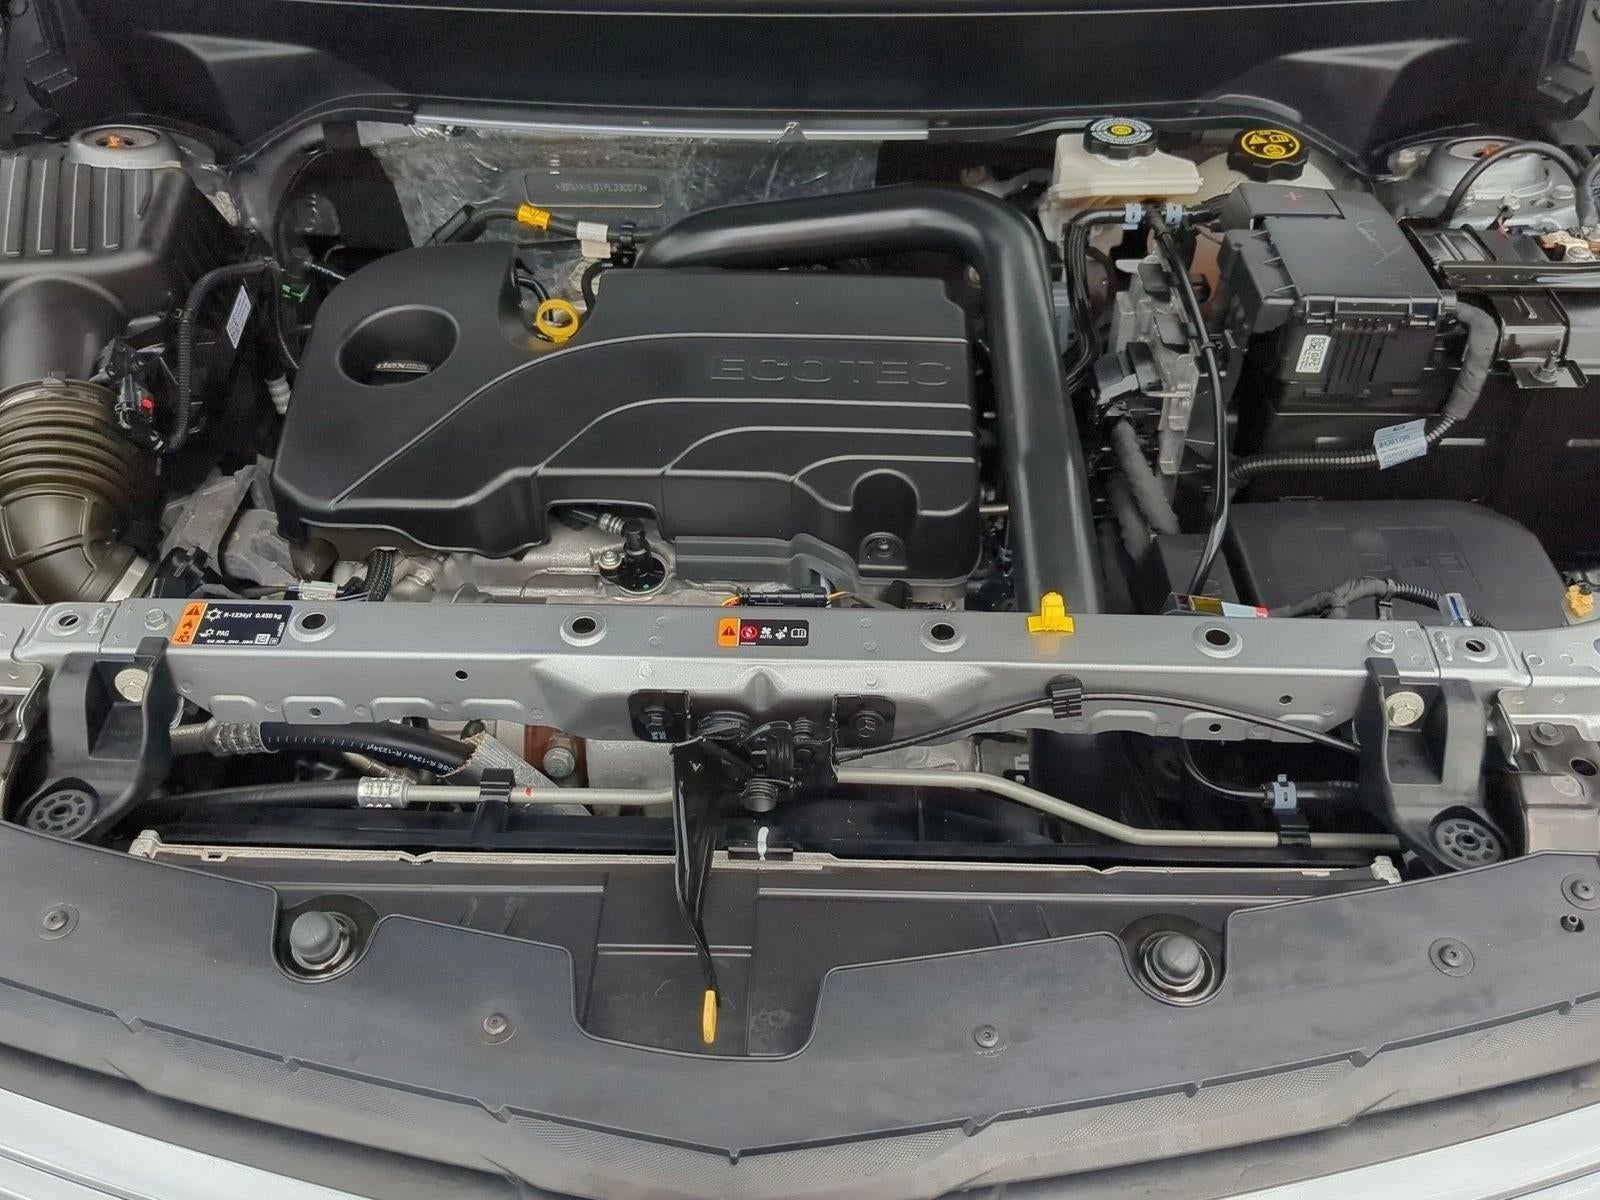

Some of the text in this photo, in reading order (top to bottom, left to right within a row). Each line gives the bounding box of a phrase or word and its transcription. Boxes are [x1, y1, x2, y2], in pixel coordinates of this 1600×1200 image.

[710, 358, 951, 385] ECOTEC
[223, 611, 252, 620] R-1234yf
[366, 743, 401, 757] R-1234yf
